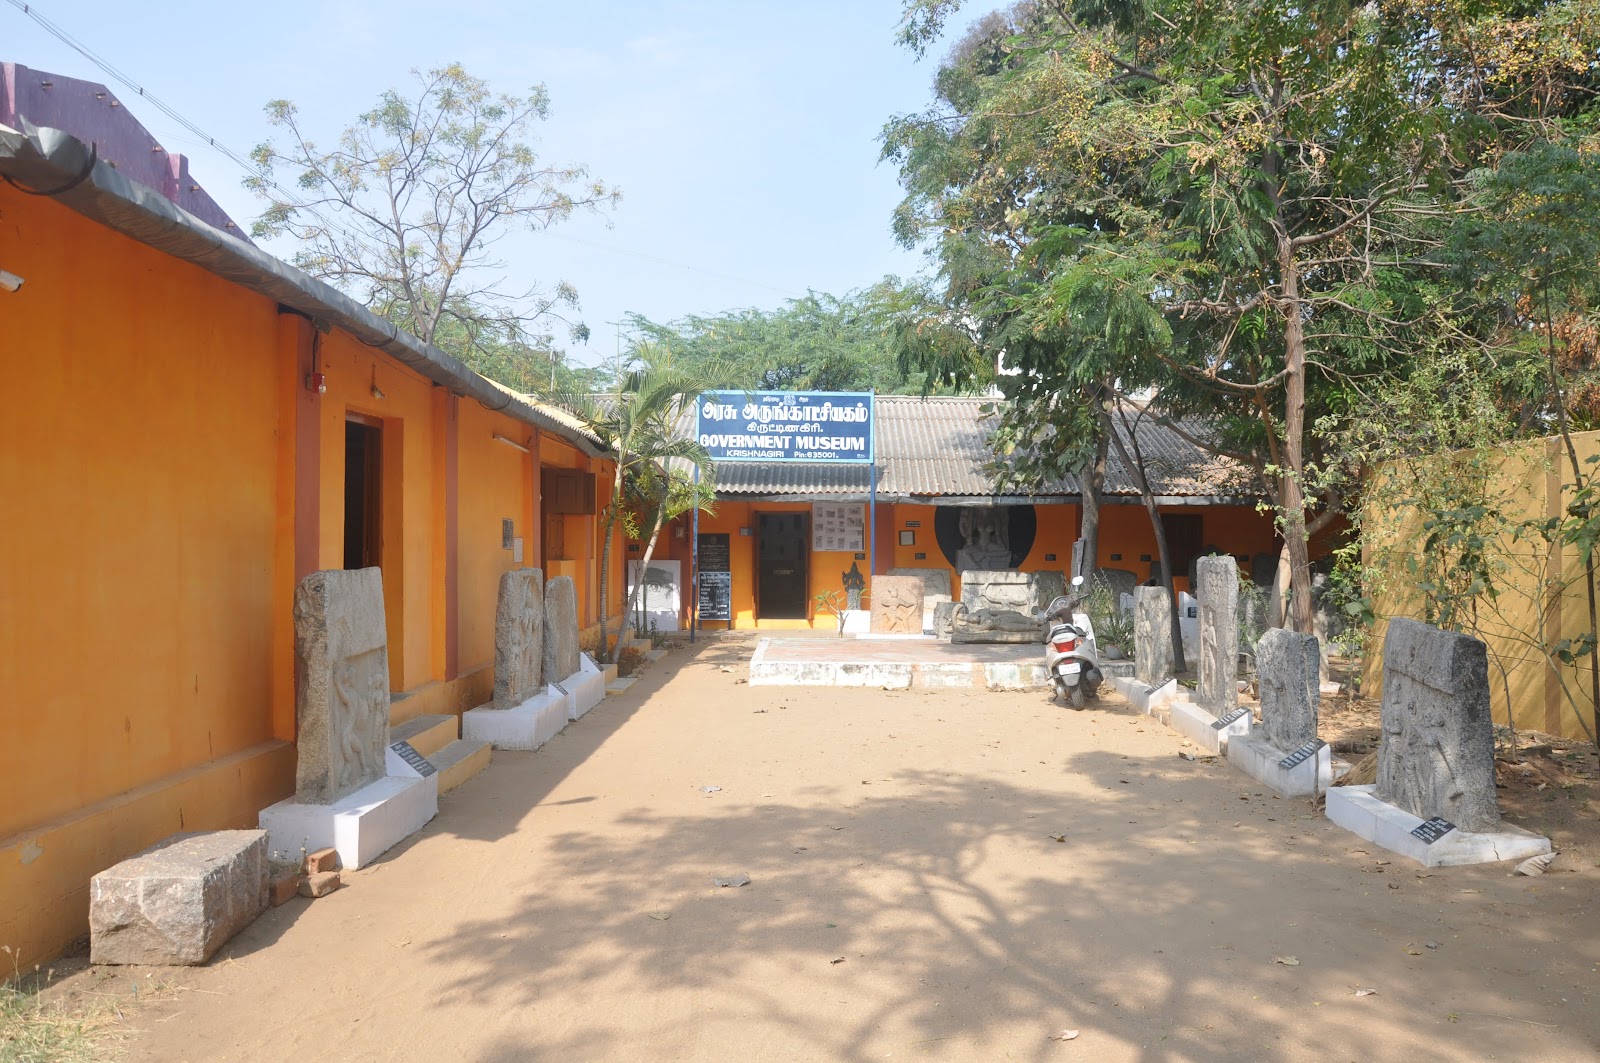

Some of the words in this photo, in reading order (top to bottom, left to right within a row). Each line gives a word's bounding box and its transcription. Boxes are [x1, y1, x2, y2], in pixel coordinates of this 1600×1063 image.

[702, 402, 738, 421] அரசு
[742, 402, 868, 423] அருங்காட்சியகம்
[700, 434, 792, 448] GOVERNMENT
[796, 436, 864, 450] MUSEUM
[727, 450, 784, 458] KRISHNAGIRI
